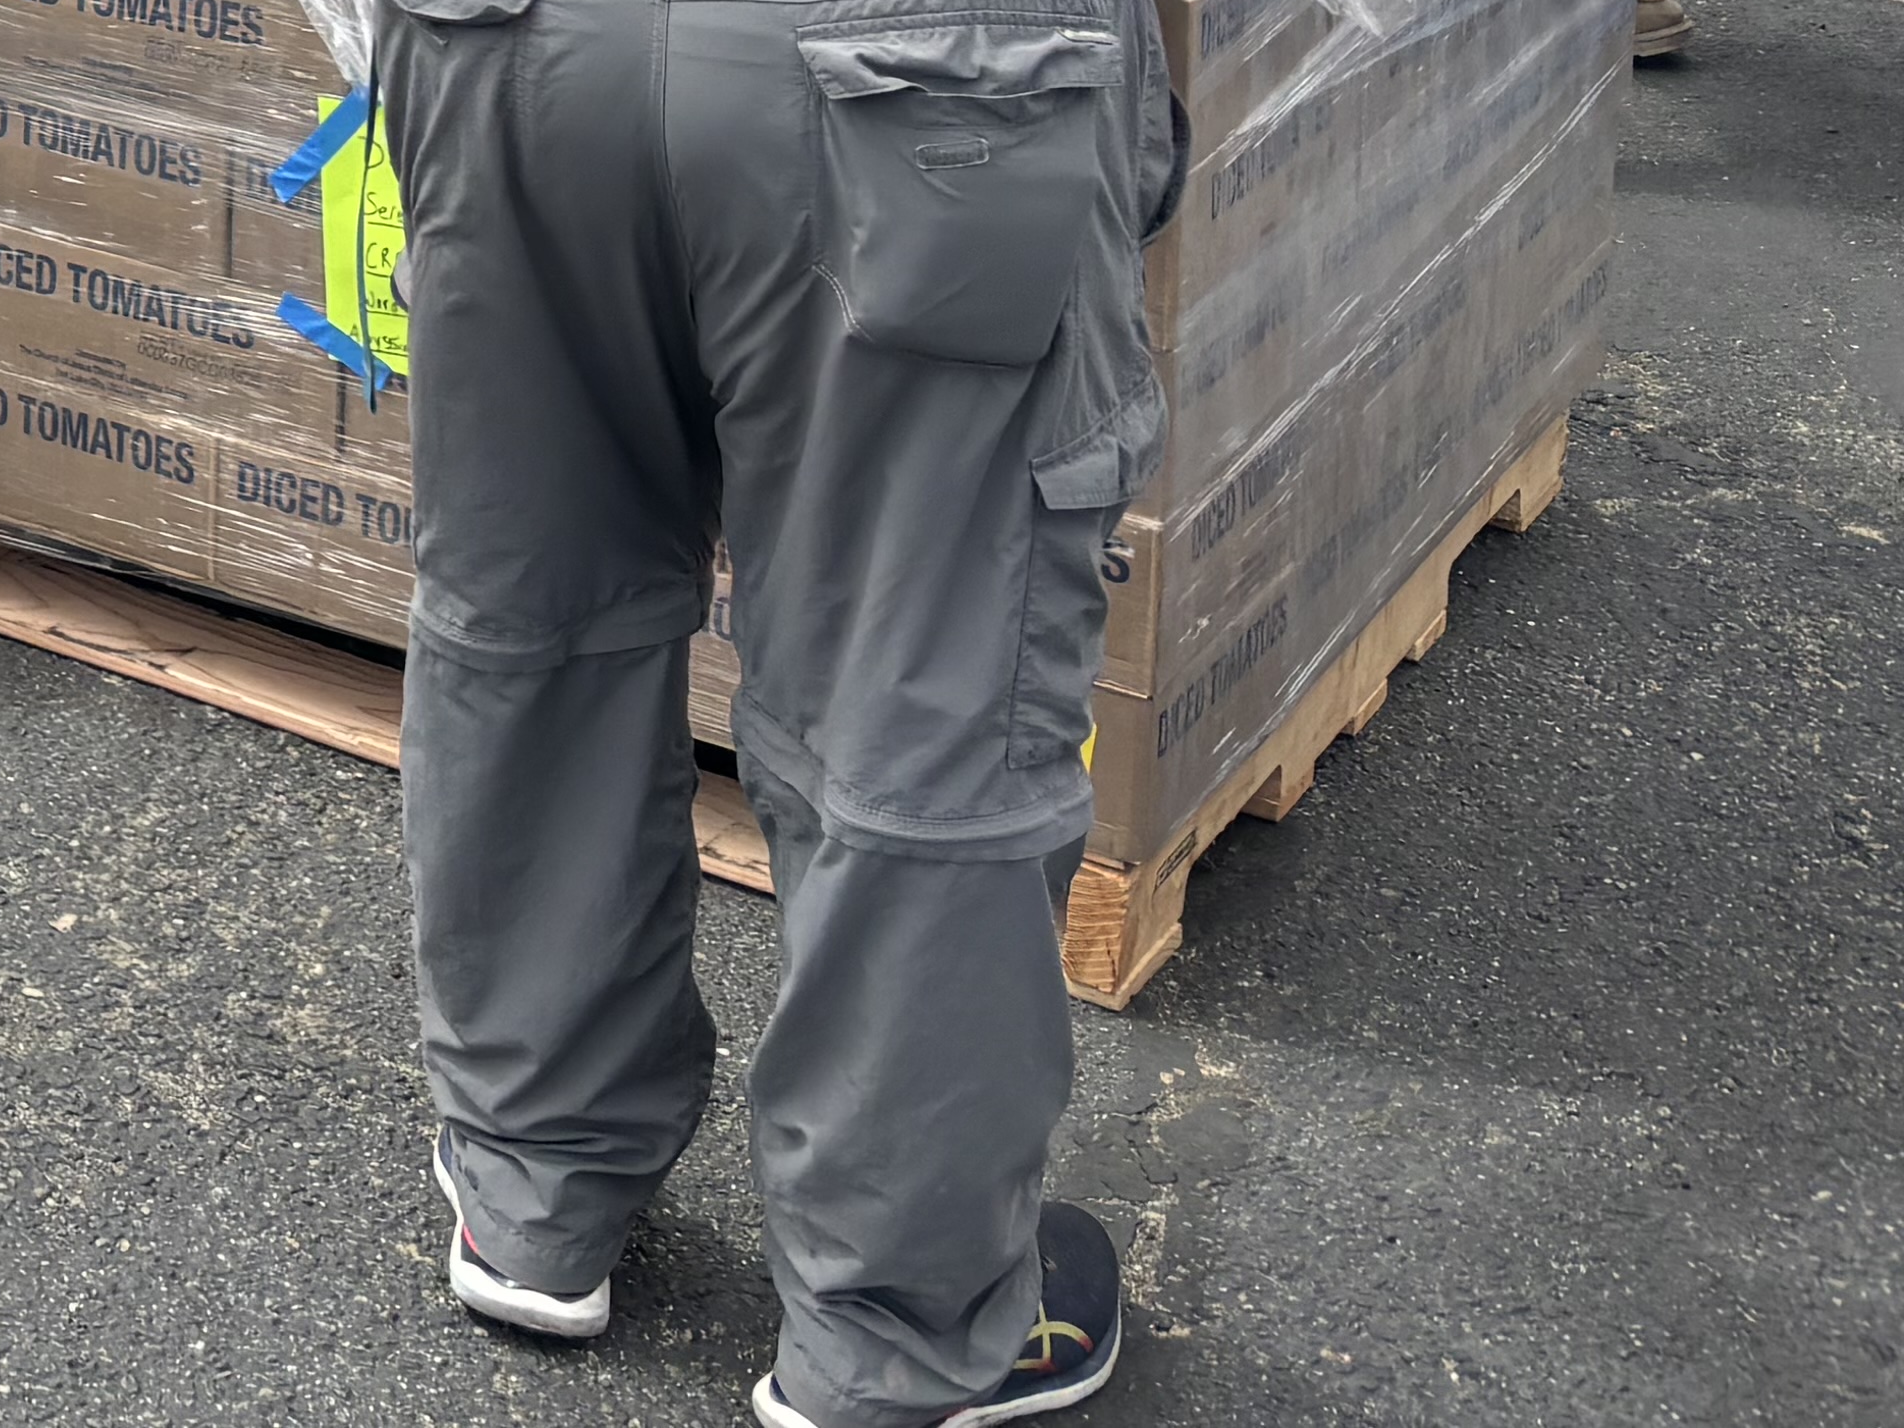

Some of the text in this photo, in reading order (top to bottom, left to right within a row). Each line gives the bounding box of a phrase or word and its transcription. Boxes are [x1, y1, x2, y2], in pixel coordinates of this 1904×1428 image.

[17, 102, 202, 188] TOMATOES
[67, 261, 256, 350] TOMATOES
[17, 393, 196, 485] TOMATOES
[236, 460, 345, 528] DICED
[1157, 593, 1288, 759] DICED TOMATOES
